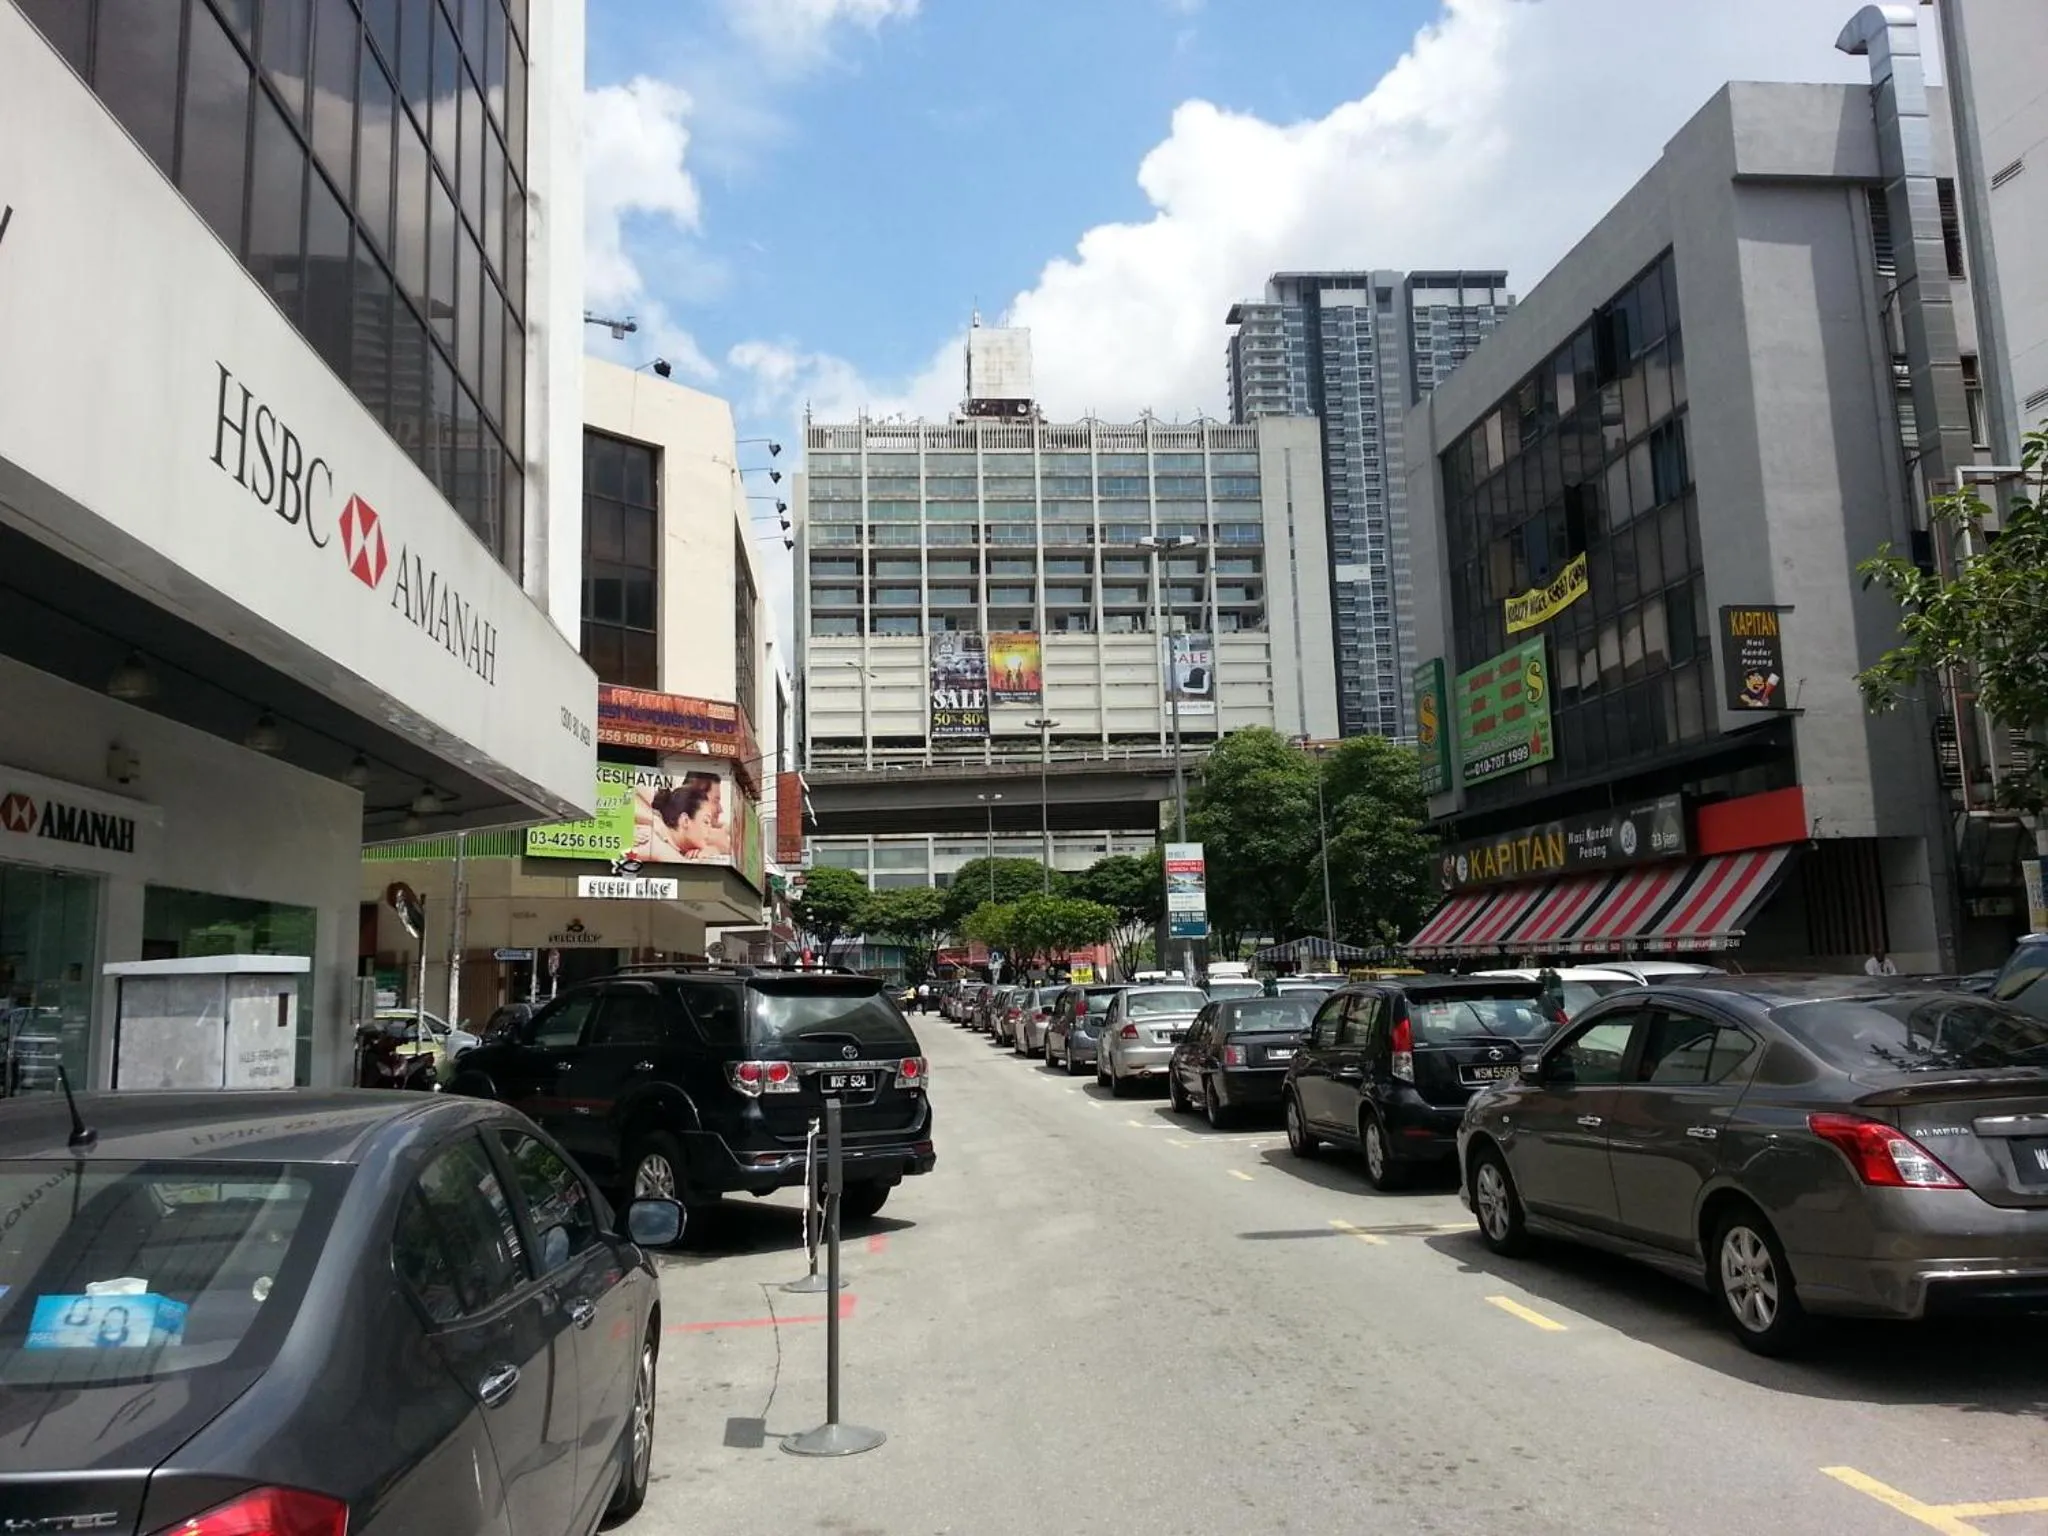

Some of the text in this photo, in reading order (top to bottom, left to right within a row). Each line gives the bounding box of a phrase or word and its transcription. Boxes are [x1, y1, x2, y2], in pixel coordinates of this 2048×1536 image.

[209, 360, 497, 686] HSBC AMANAH
[1730, 611, 1777, 636] KAPITAN
[1741, 648, 1772, 656] Kandar
[1746, 639, 1765, 647] Nasi
[1741, 658, 1773, 667] Penang
[933, 688, 985, 710] SALE
[623, 731, 653, 746] 1889
[709, 742, 736, 755] 1889
[37, 801, 135, 853] AMANAH
[529, 830, 621, 849] 03-4256 6155
[1470, 831, 1567, 880] KAPITAN
[1568, 829, 1586, 844] Nasi
[1586, 825, 1614, 842] Kandar
[1579, 846, 1607, 859] Penang
[588, 879, 672, 898] SUSHI KING
[850, 1074, 867, 1088] 524
